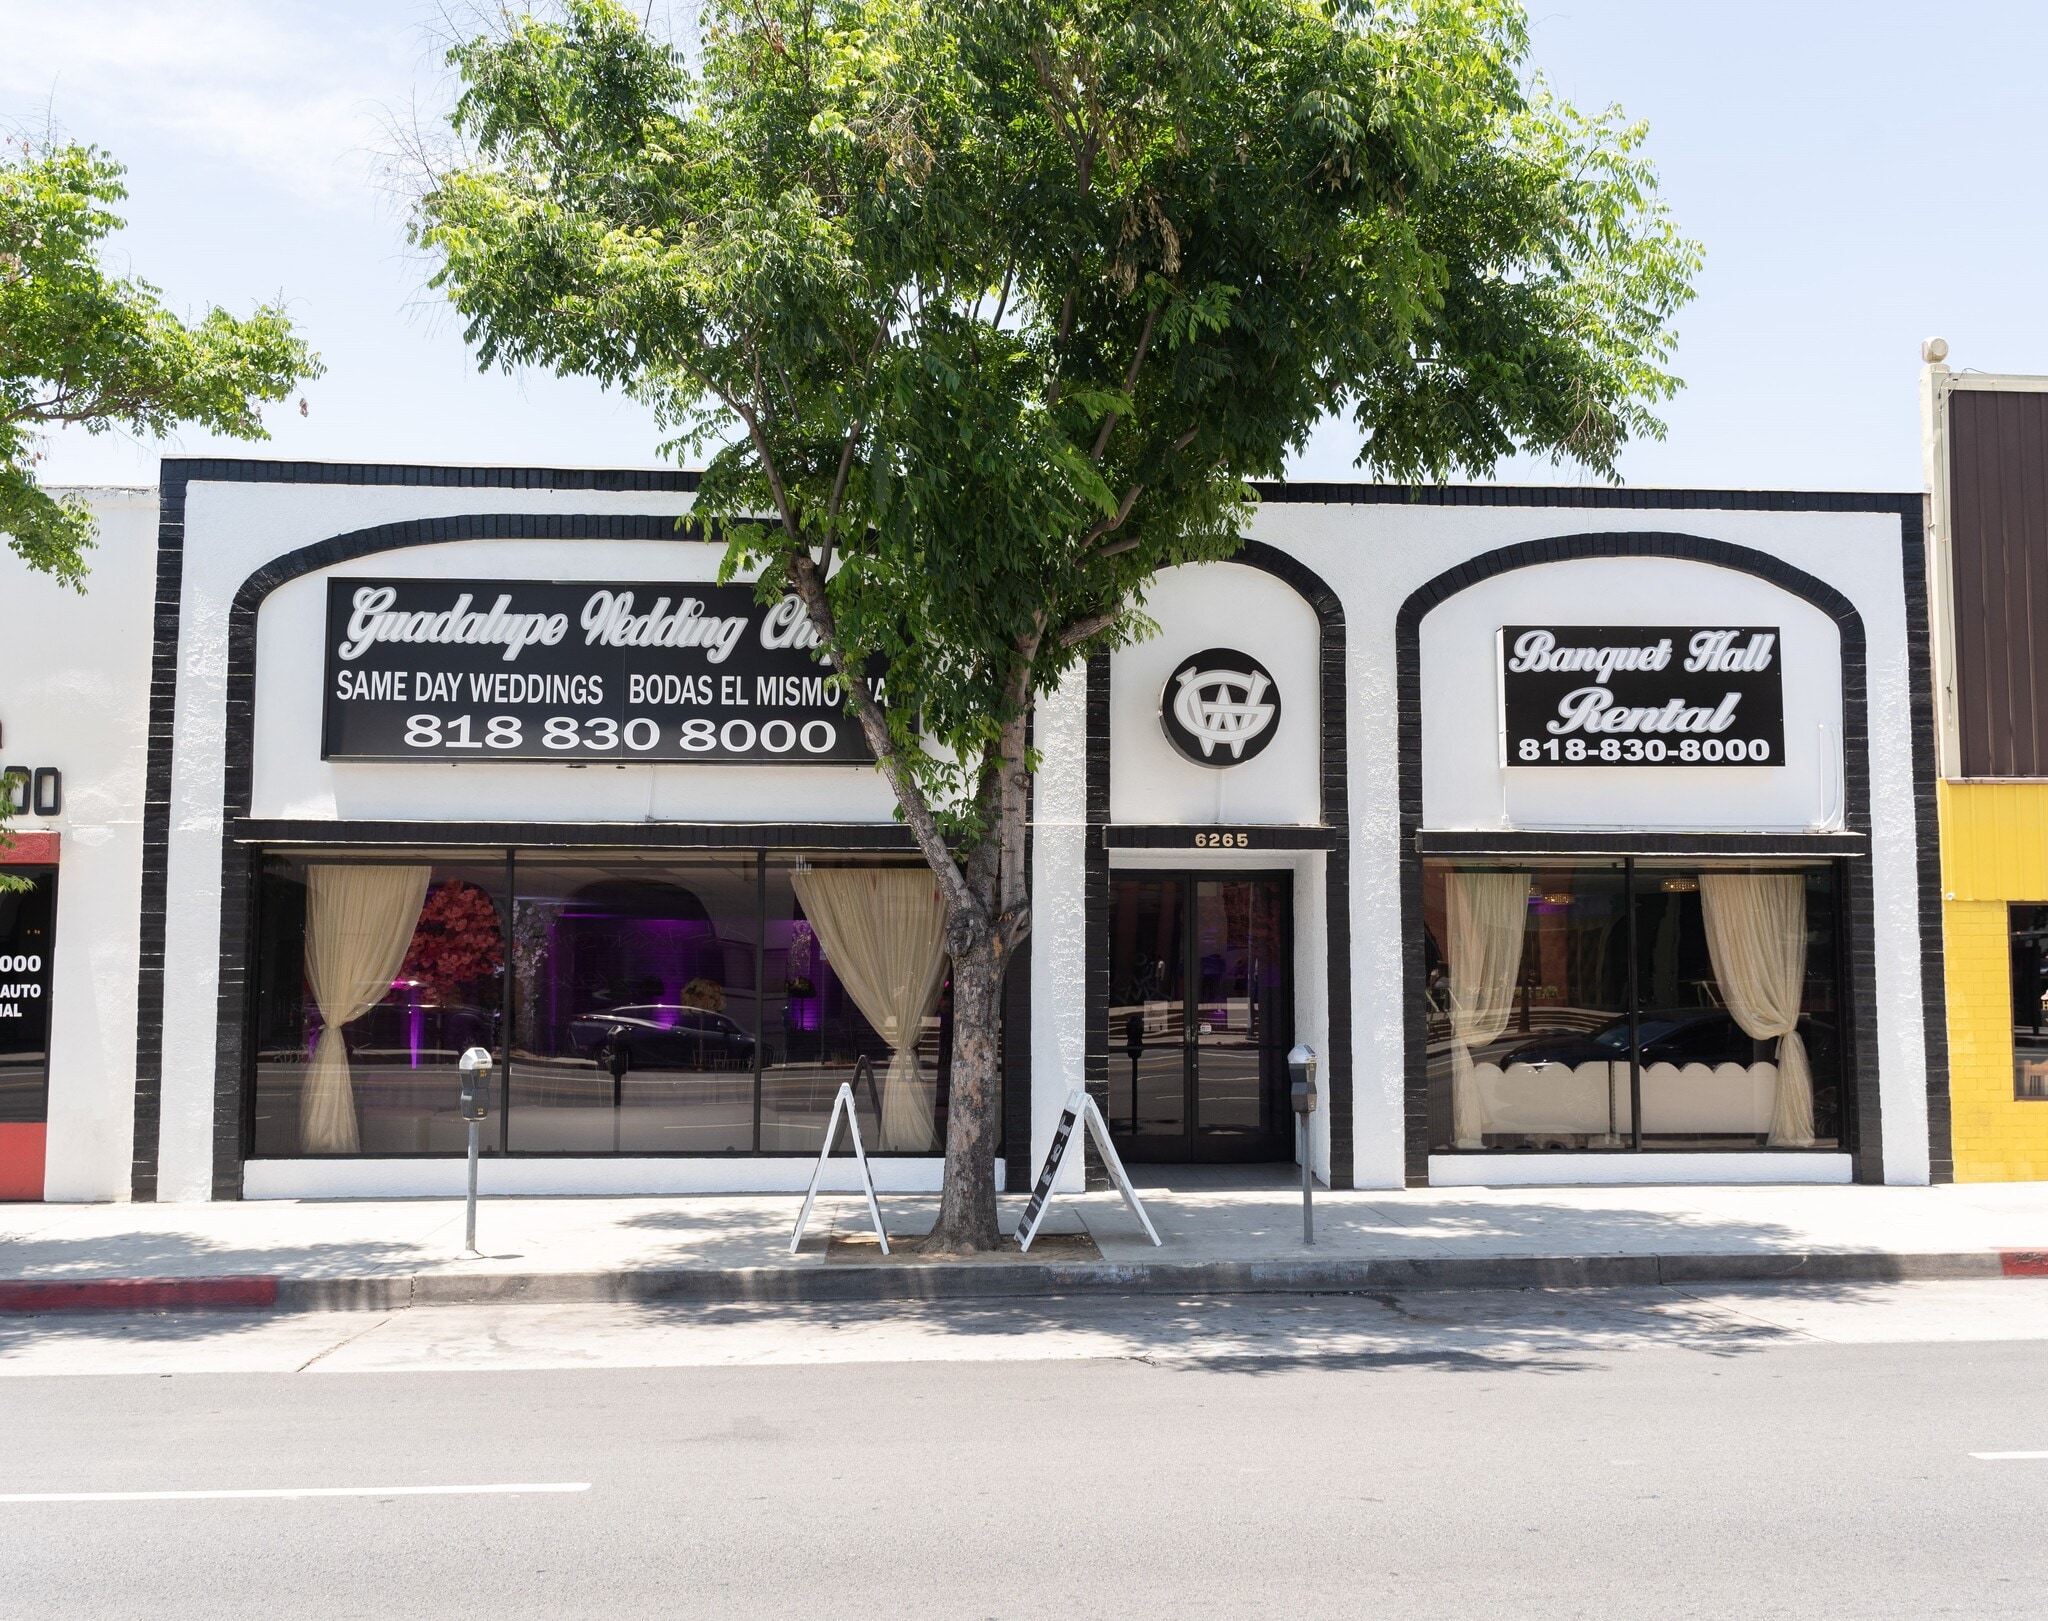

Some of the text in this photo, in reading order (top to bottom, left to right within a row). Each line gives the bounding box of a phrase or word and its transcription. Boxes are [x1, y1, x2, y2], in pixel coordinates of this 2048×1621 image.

[339, 586, 569, 661] Guadalupe
[580, 589, 748, 664] Wedding
[1508, 630, 1775, 683] Banquet Hall
[336, 670, 604, 704] SAME DAY WEDDINGS
[629, 674, 713, 705] BODAS
[721, 676, 749, 705] EL
[756, 676, 841, 706] MISMO
[1546, 687, 1742, 735] Rental
[404, 714, 837, 753] 818 830 8000
[1518, 738, 1770, 762] 818-830-8000
[1195, 833, 1249, 847] 6265
[0, 984, 41, 998] AUTO
